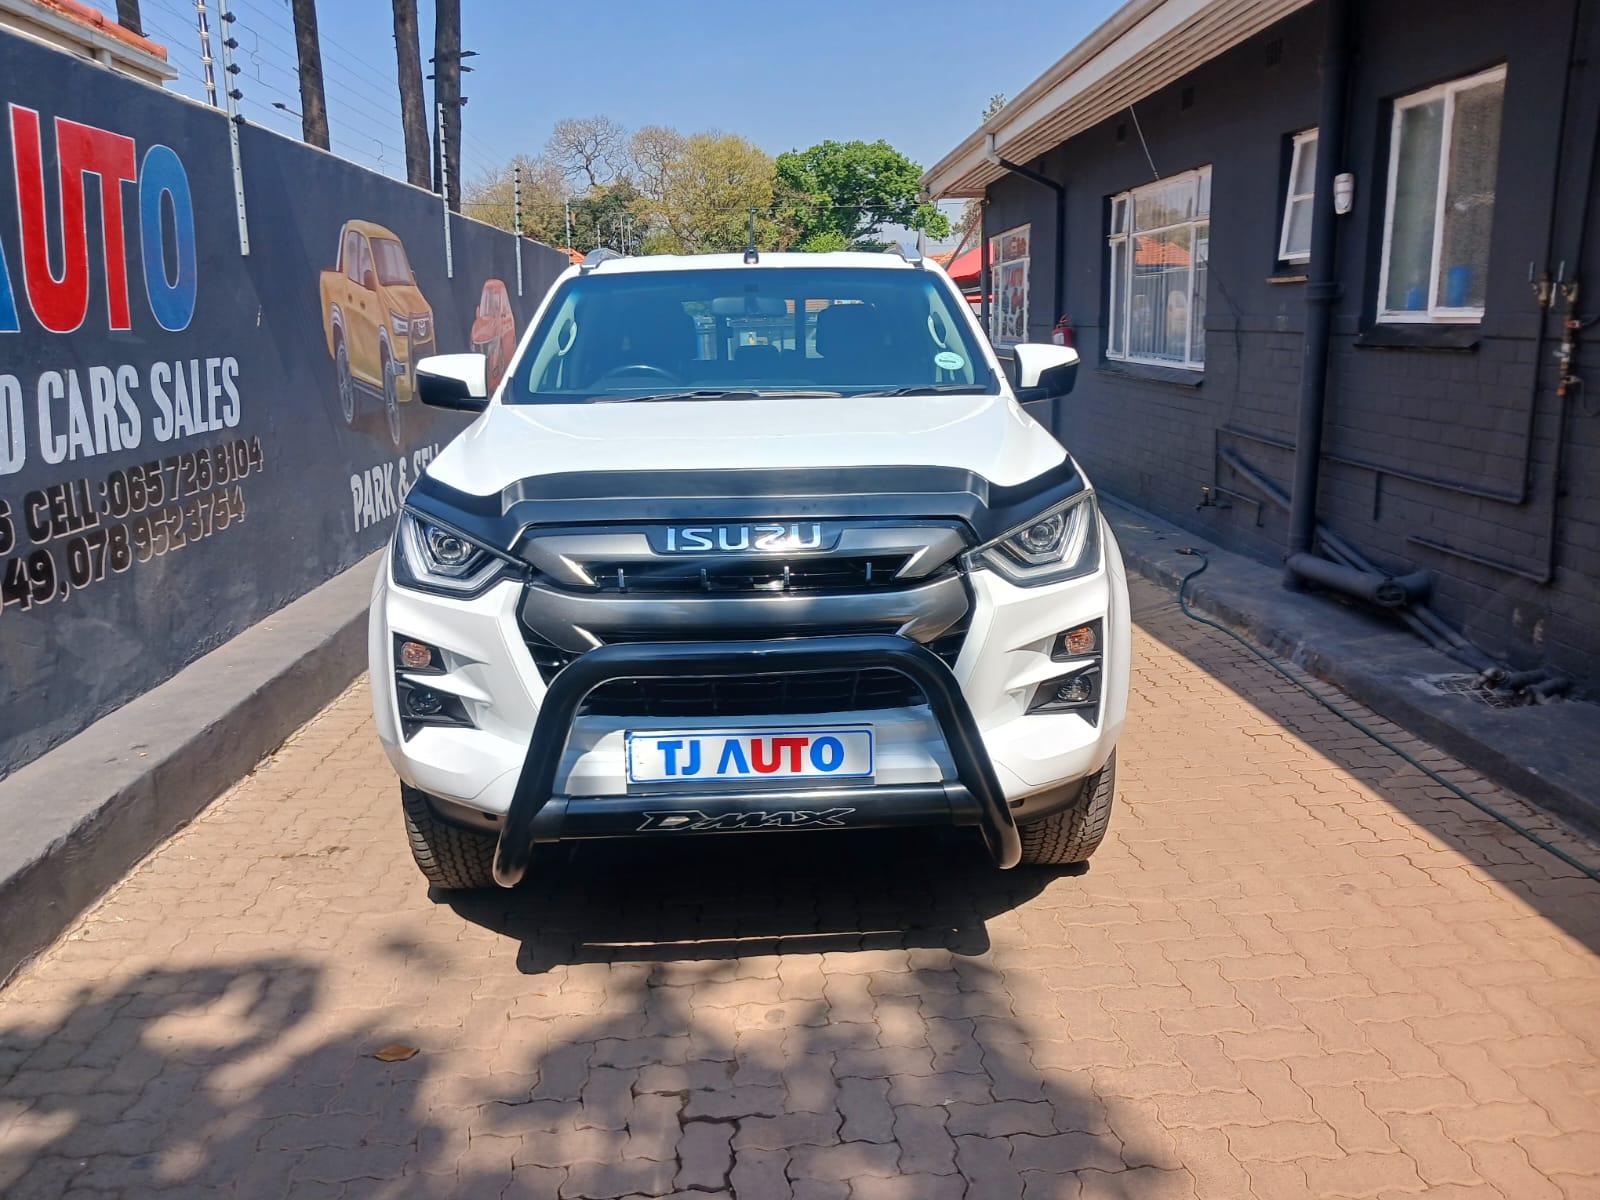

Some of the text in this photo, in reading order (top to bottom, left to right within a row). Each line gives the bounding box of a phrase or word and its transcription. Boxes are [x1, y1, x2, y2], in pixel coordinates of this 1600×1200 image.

[0, 102, 197, 334] UTO
[37, 365, 142, 465] CARS
[151, 356, 241, 442] SALES
[165, 448, 213, 501] 726
[214, 435, 264, 485] 8104
[350, 462, 398, 533] PARK
[398, 456, 410, 505] &
[0, 485, 246, 612] 49,078 952 3754
[667, 523, 822, 551] ISUZU
[656, 735, 845, 776] TJ AUTO
